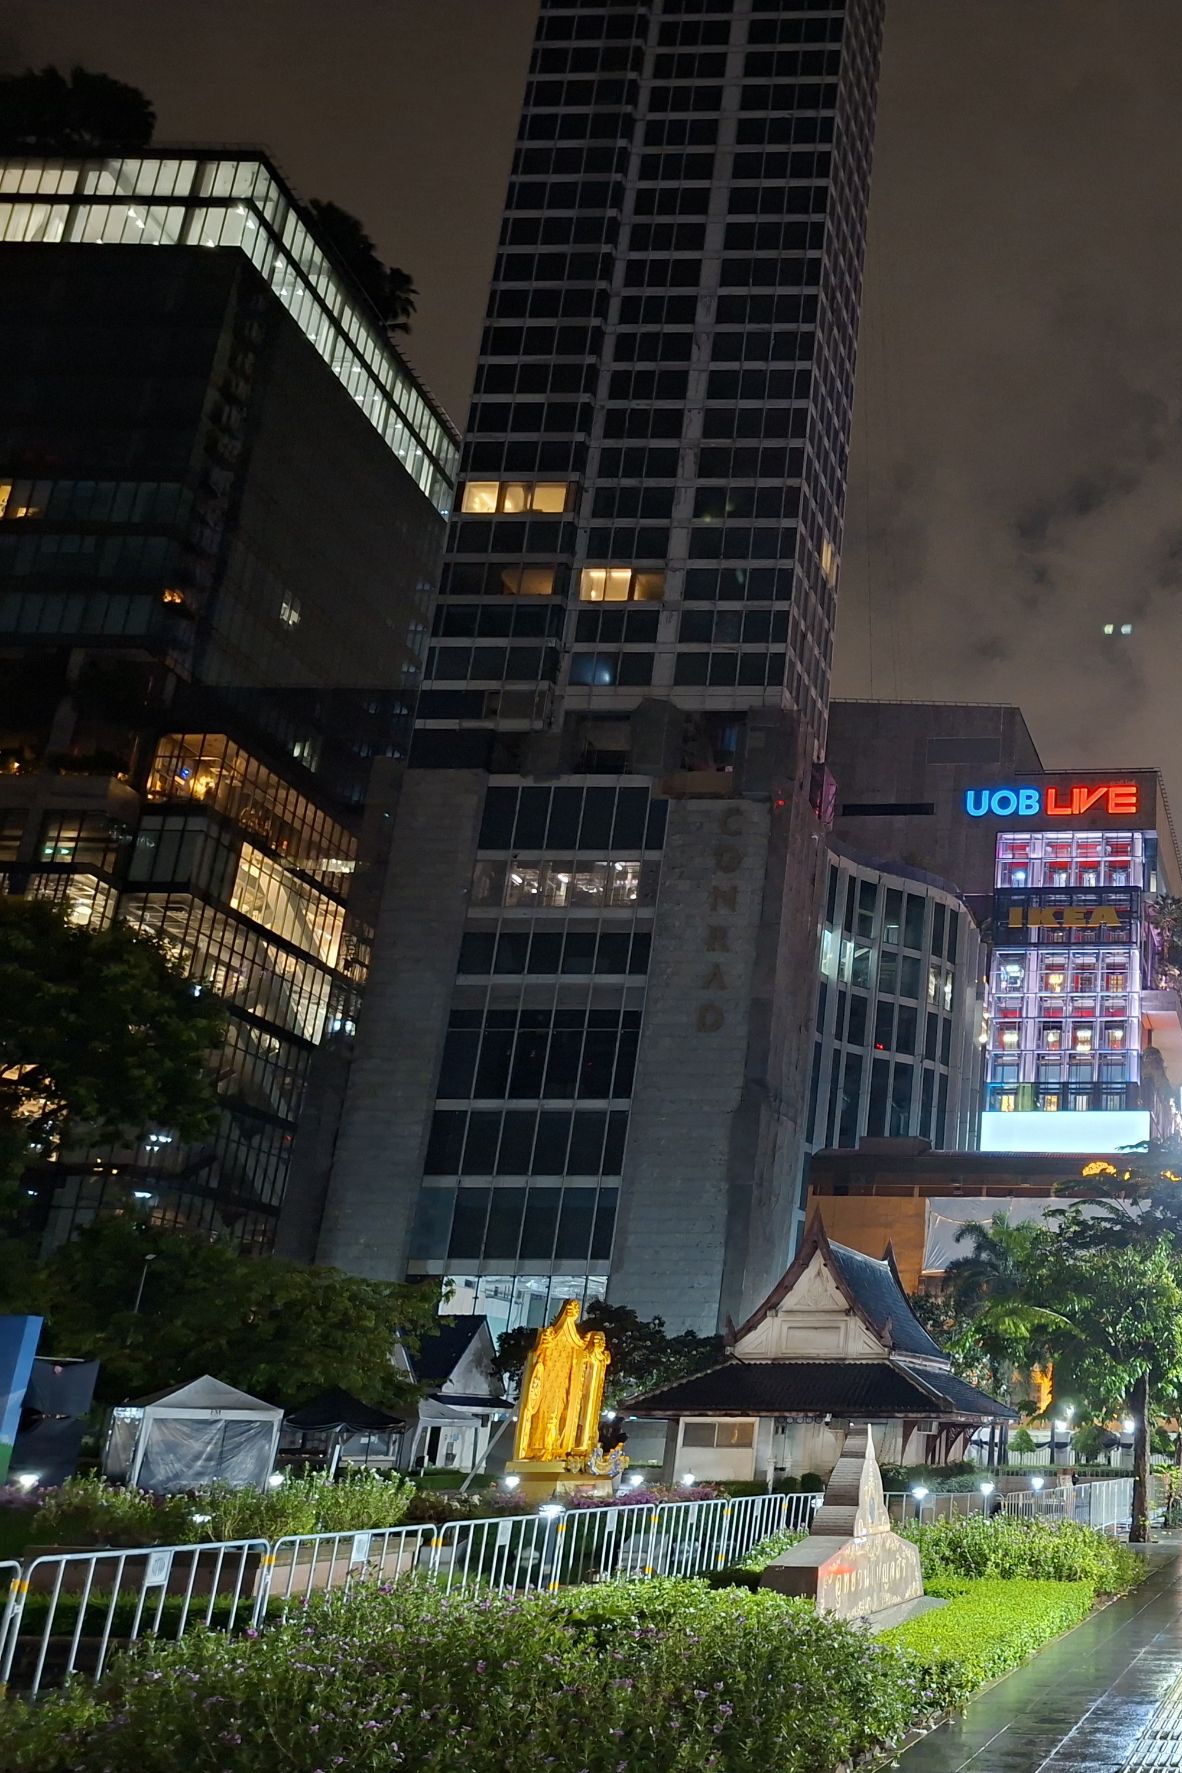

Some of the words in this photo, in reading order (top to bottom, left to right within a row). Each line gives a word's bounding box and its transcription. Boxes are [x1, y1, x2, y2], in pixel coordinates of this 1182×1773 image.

[966, 788, 1040, 816] UOB
[1045, 785, 1138, 815] LIVE
[1008, 906, 1120, 928] IKEA
